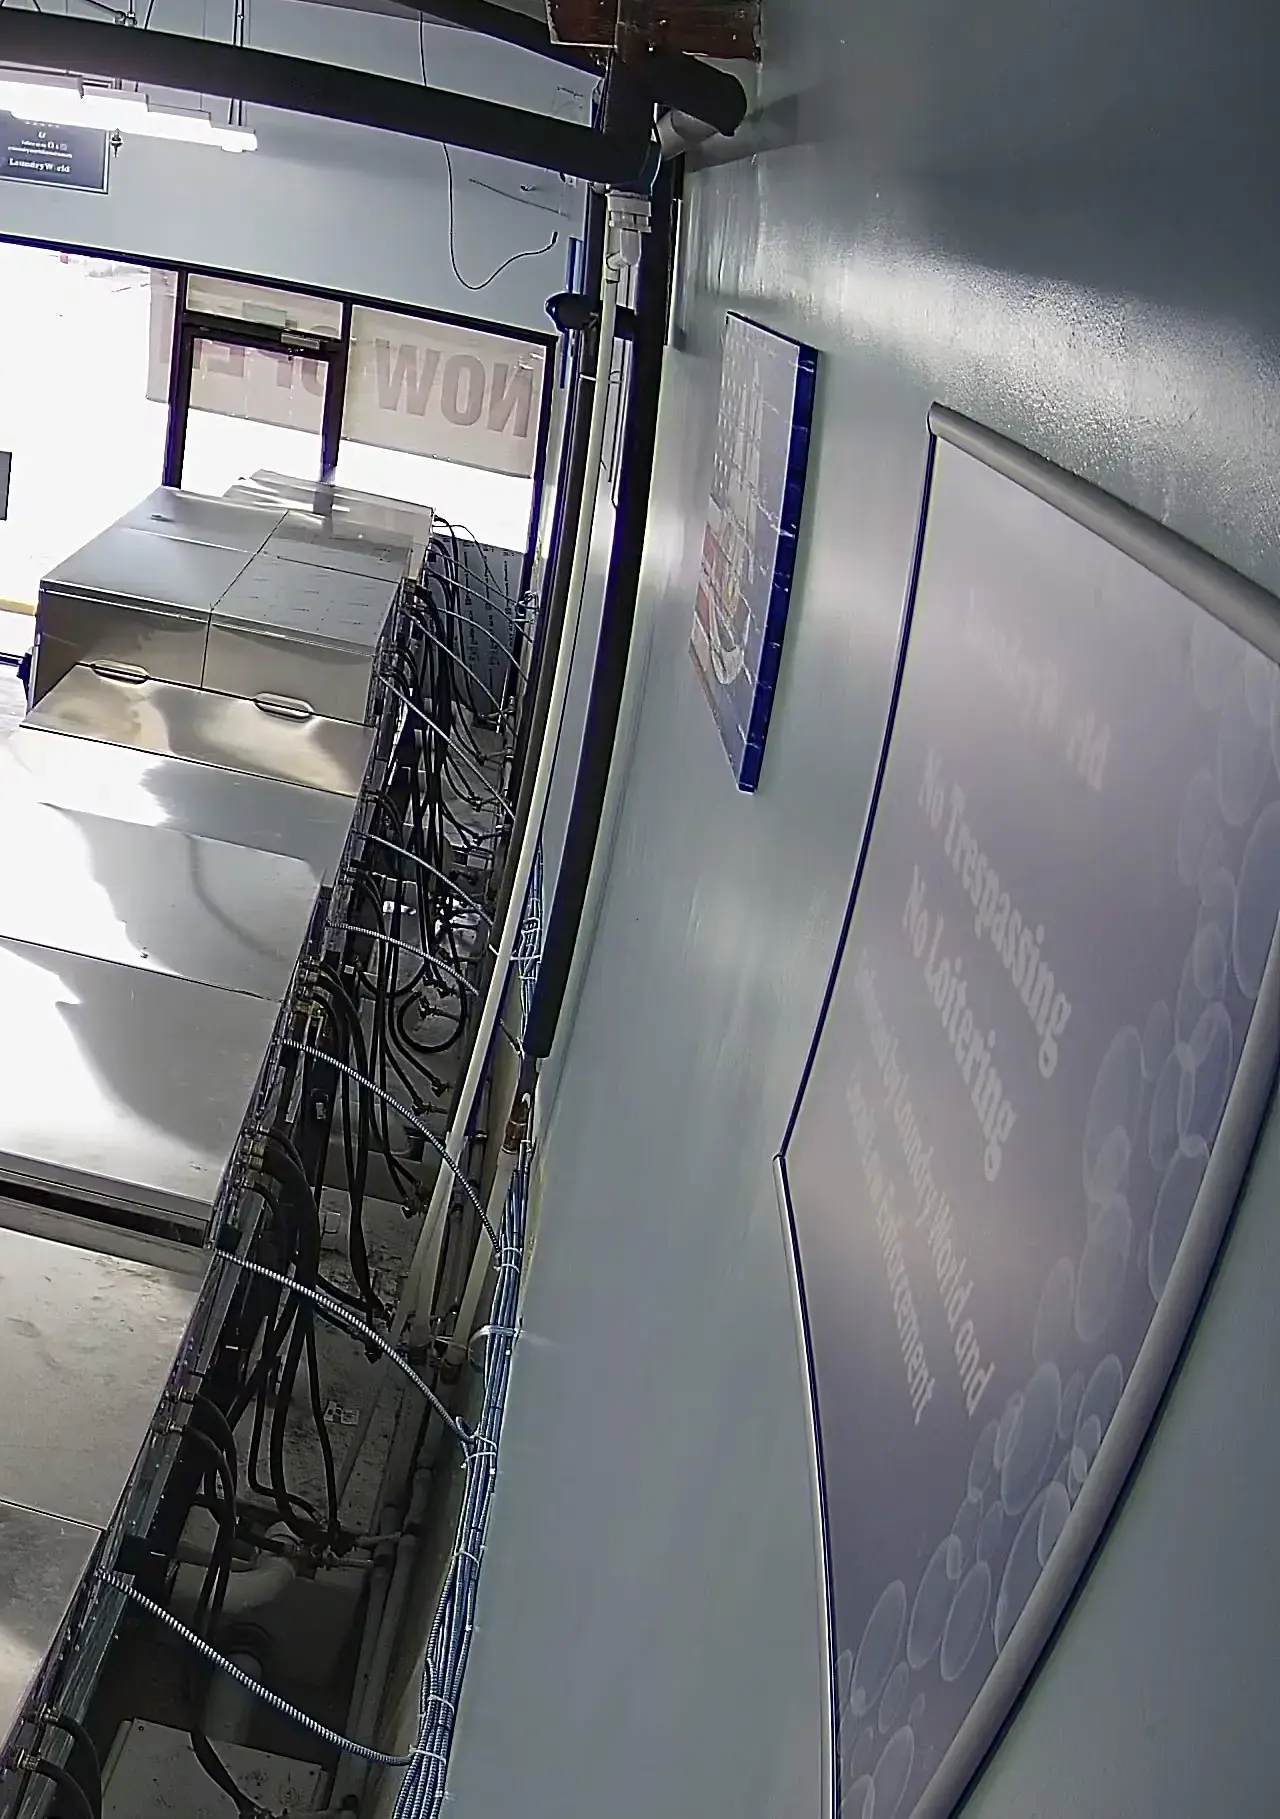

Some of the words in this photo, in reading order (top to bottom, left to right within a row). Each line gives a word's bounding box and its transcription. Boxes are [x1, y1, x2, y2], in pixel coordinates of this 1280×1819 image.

[903, 863, 928, 959] No
[924, 915, 1017, 1182] Loitering
[917, 747, 945, 830] No
[943, 780, 1072, 1079] Trespassing
[927, 1191, 974, 1333] World
[954, 1319, 997, 1417] and
